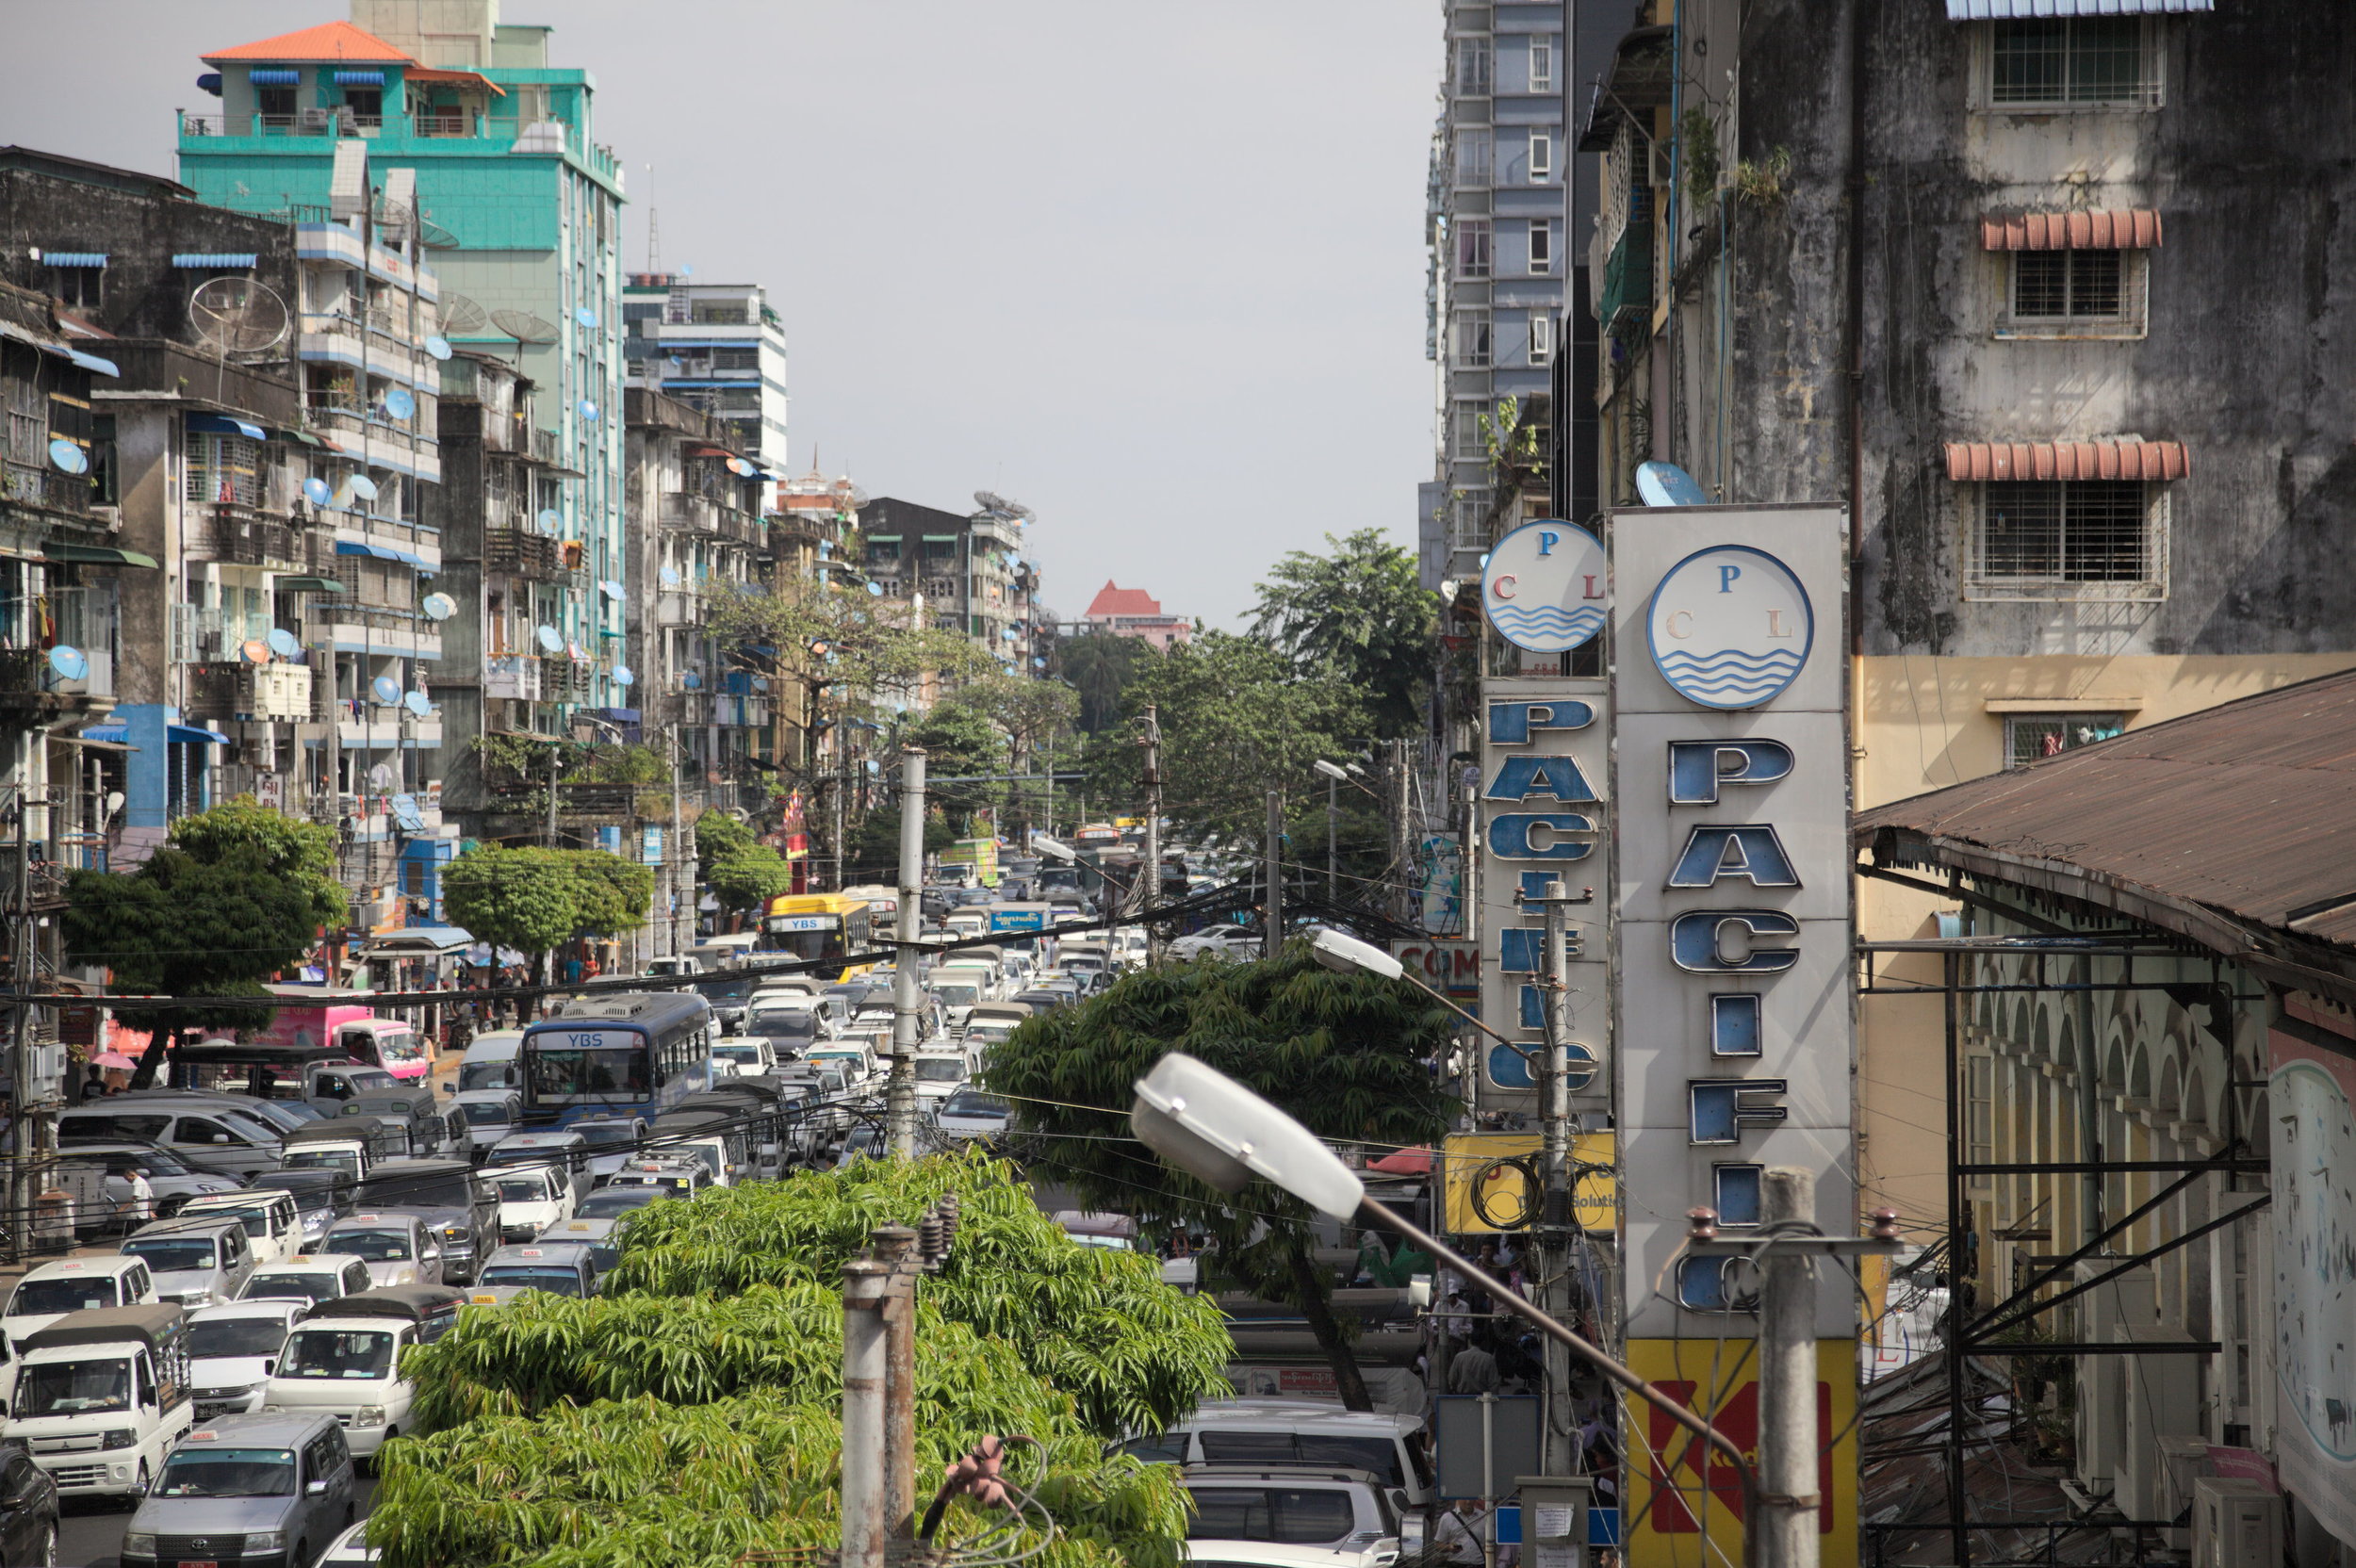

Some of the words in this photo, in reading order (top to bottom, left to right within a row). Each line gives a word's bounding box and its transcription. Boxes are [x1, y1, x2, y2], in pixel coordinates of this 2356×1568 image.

[1538, 531, 1561, 556] P
[1494, 574, 1518, 599] C
[1582, 575, 1606, 599] L
[1717, 565, 1742, 594] P
[1666, 609, 1694, 639] C
[1766, 609, 1793, 638] L
[1481, 698, 1604, 1091] PACIFIC
[792, 919, 817, 928] YBS
[568, 1033, 603, 1048] YBS
[634, 1035, 644, 1045] 4
